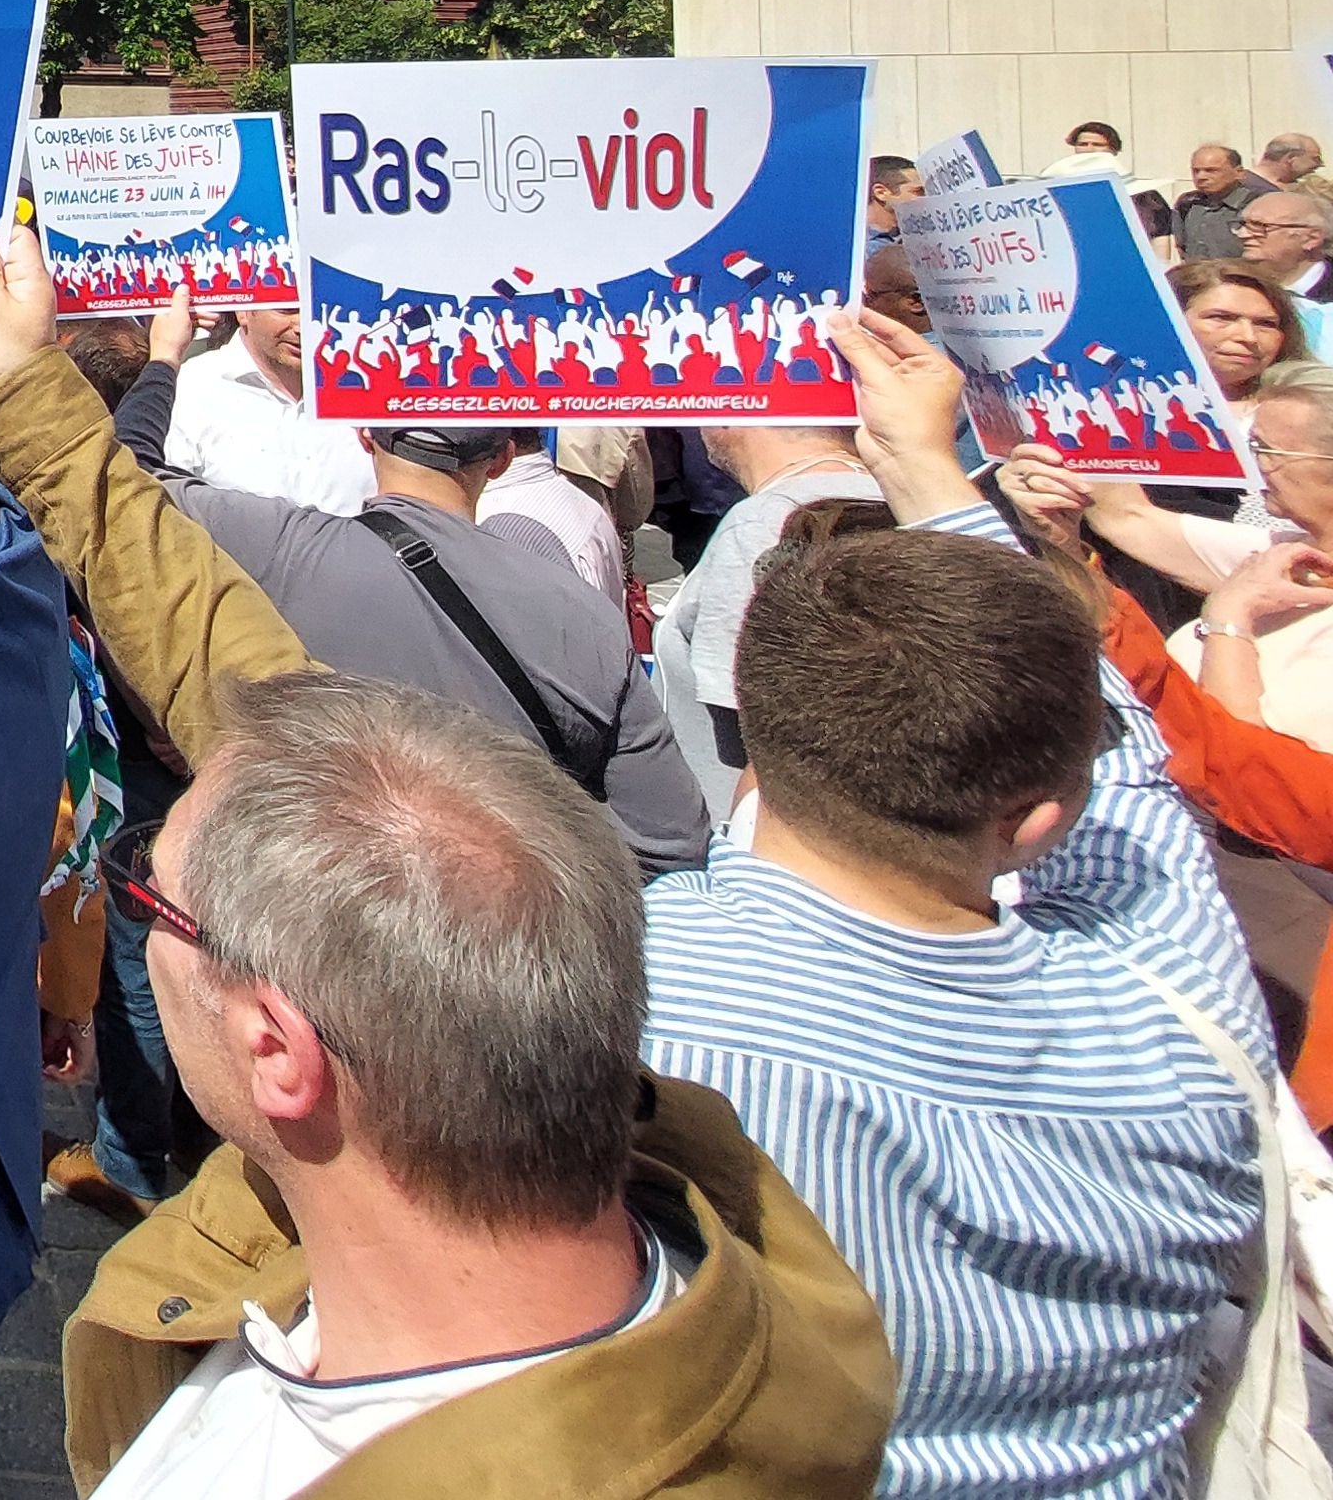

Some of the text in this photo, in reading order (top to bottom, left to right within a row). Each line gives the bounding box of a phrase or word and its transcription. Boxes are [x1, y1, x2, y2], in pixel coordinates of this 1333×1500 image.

[34, 121, 233, 147] COURBEVOIE SE LÈVE CONTRE
[40, 155, 60, 171] LA
[65, 145, 119, 178] HAINE
[125, 151, 153, 171] DES
[318, 106, 714, 216] Ras-le-viol
[44, 187, 119, 206] DIMANCHE
[123, 187, 145, 203] 23
[150, 184, 185, 202] JUIN
[188, 182, 201, 200] À
[984, 194, 1053, 224] CONTRE
[979, 293, 1012, 316] JUIN
[1016, 287, 1032, 315] À
[386, 394, 769, 414] #CESSEZLEVIOL #TOUCHEPASAMONFEUJ
[1064, 457, 1161, 472] SAMONFEUJ
